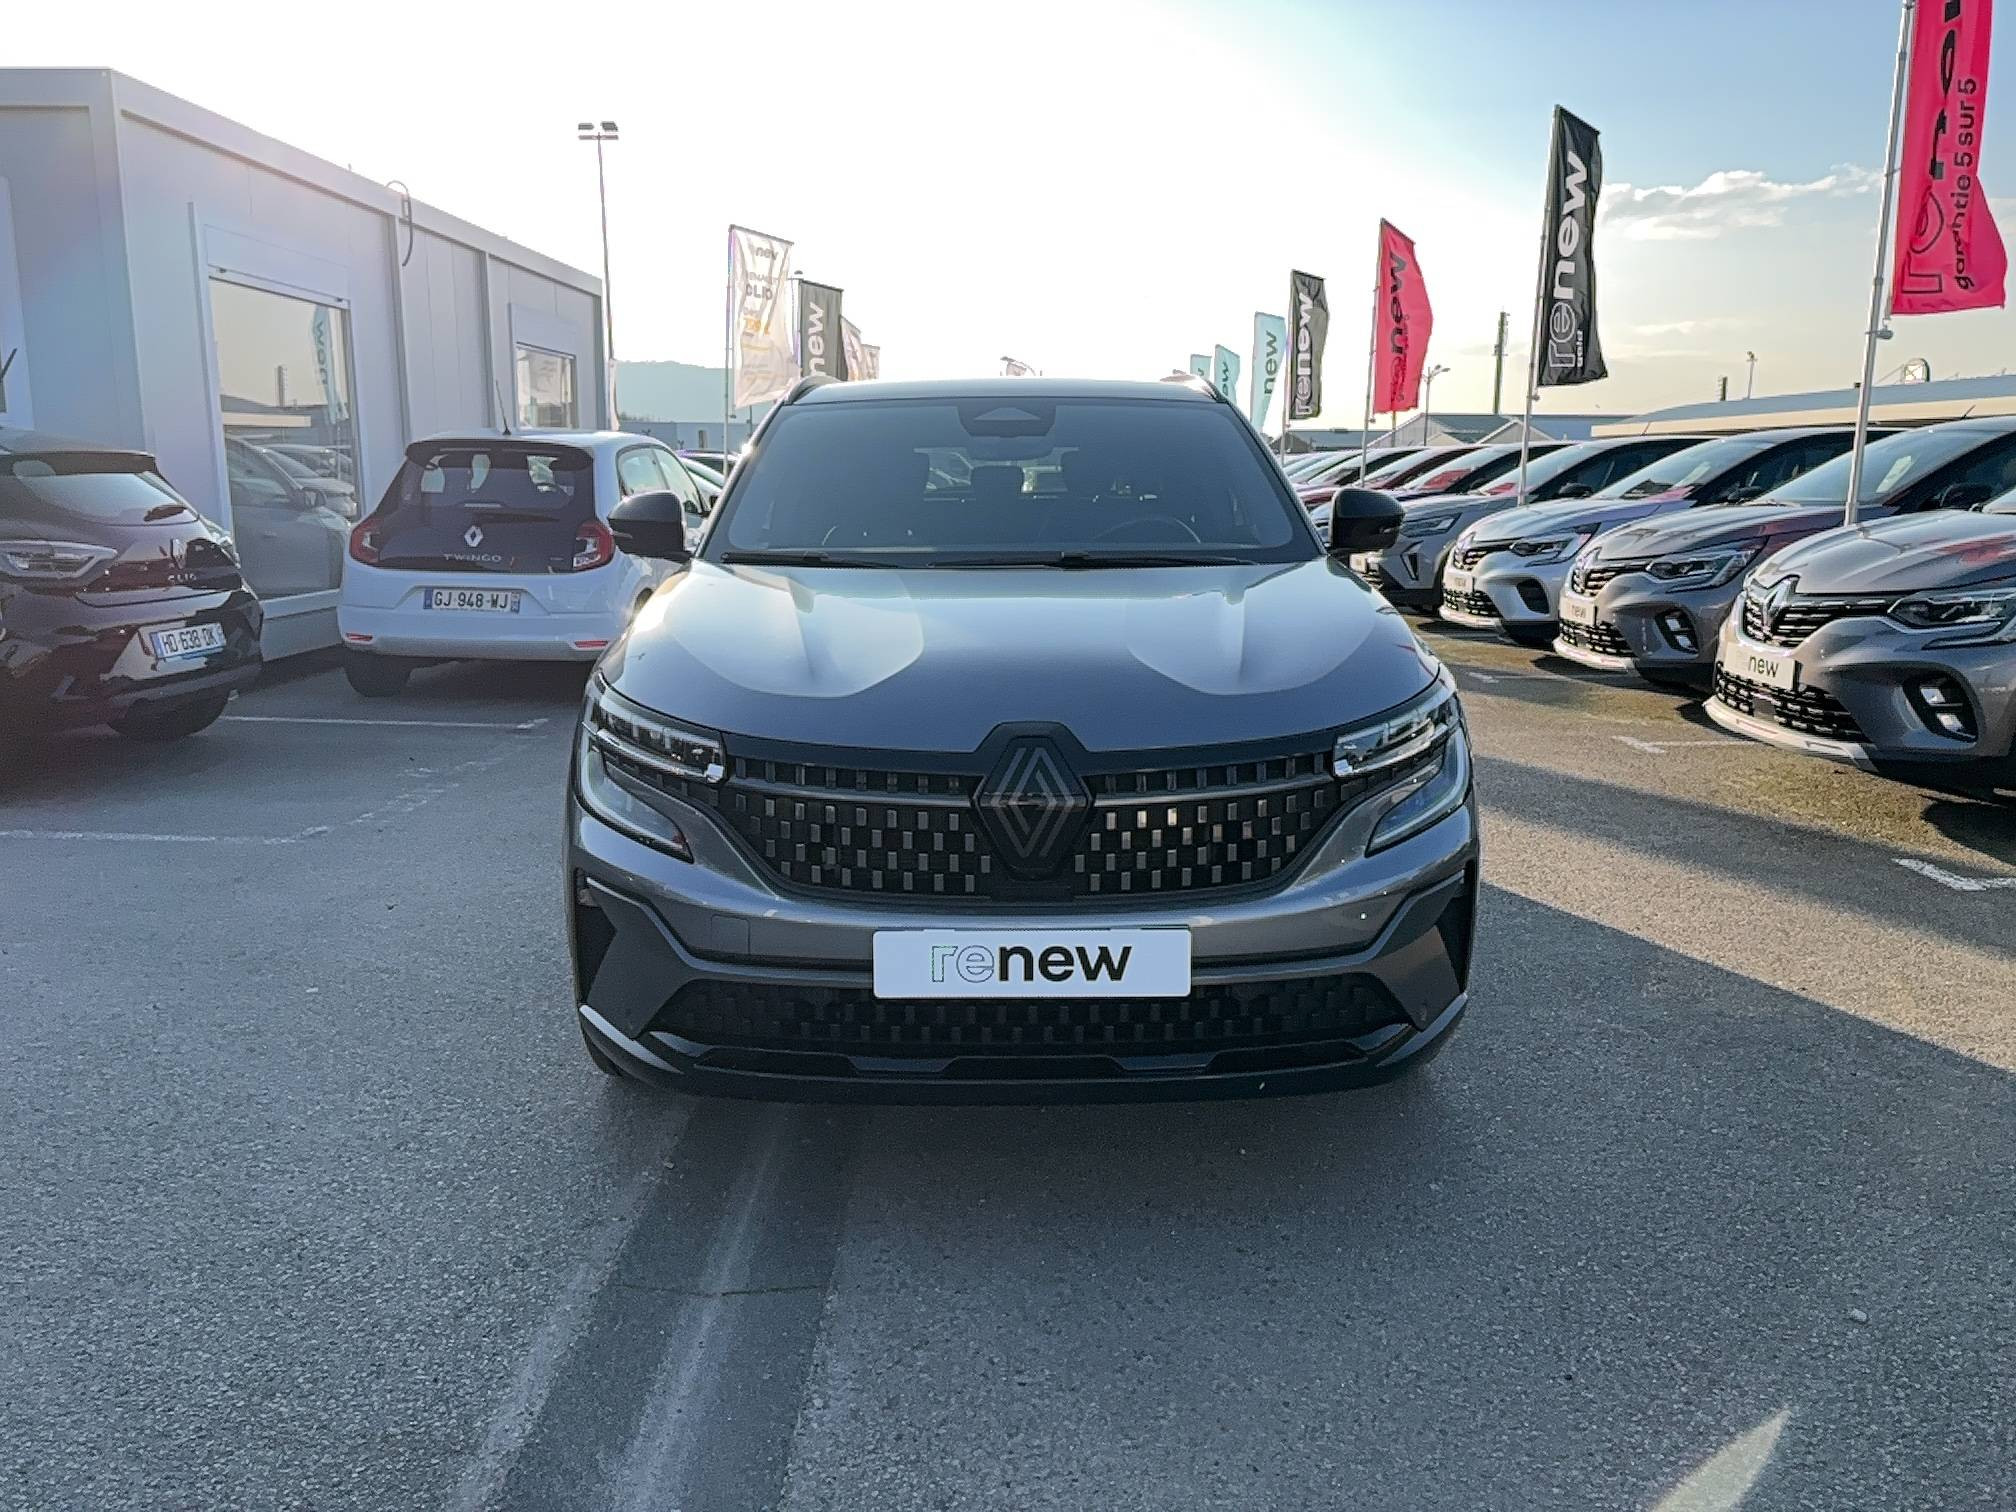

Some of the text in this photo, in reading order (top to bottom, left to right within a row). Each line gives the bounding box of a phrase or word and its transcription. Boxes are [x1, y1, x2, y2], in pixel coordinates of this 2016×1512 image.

[1902, 0, 1961, 293] rene
[1951, 78, 1977, 290] garantie 5 sur 5
[1549, 151, 1588, 368] renew
[1263, 330, 1278, 394] new
[1296, 292, 1314, 416] renew
[444, 553, 502, 563] TWINGO
[1748, 655, 1779, 678] new
[931, 945, 1132, 983] renew
